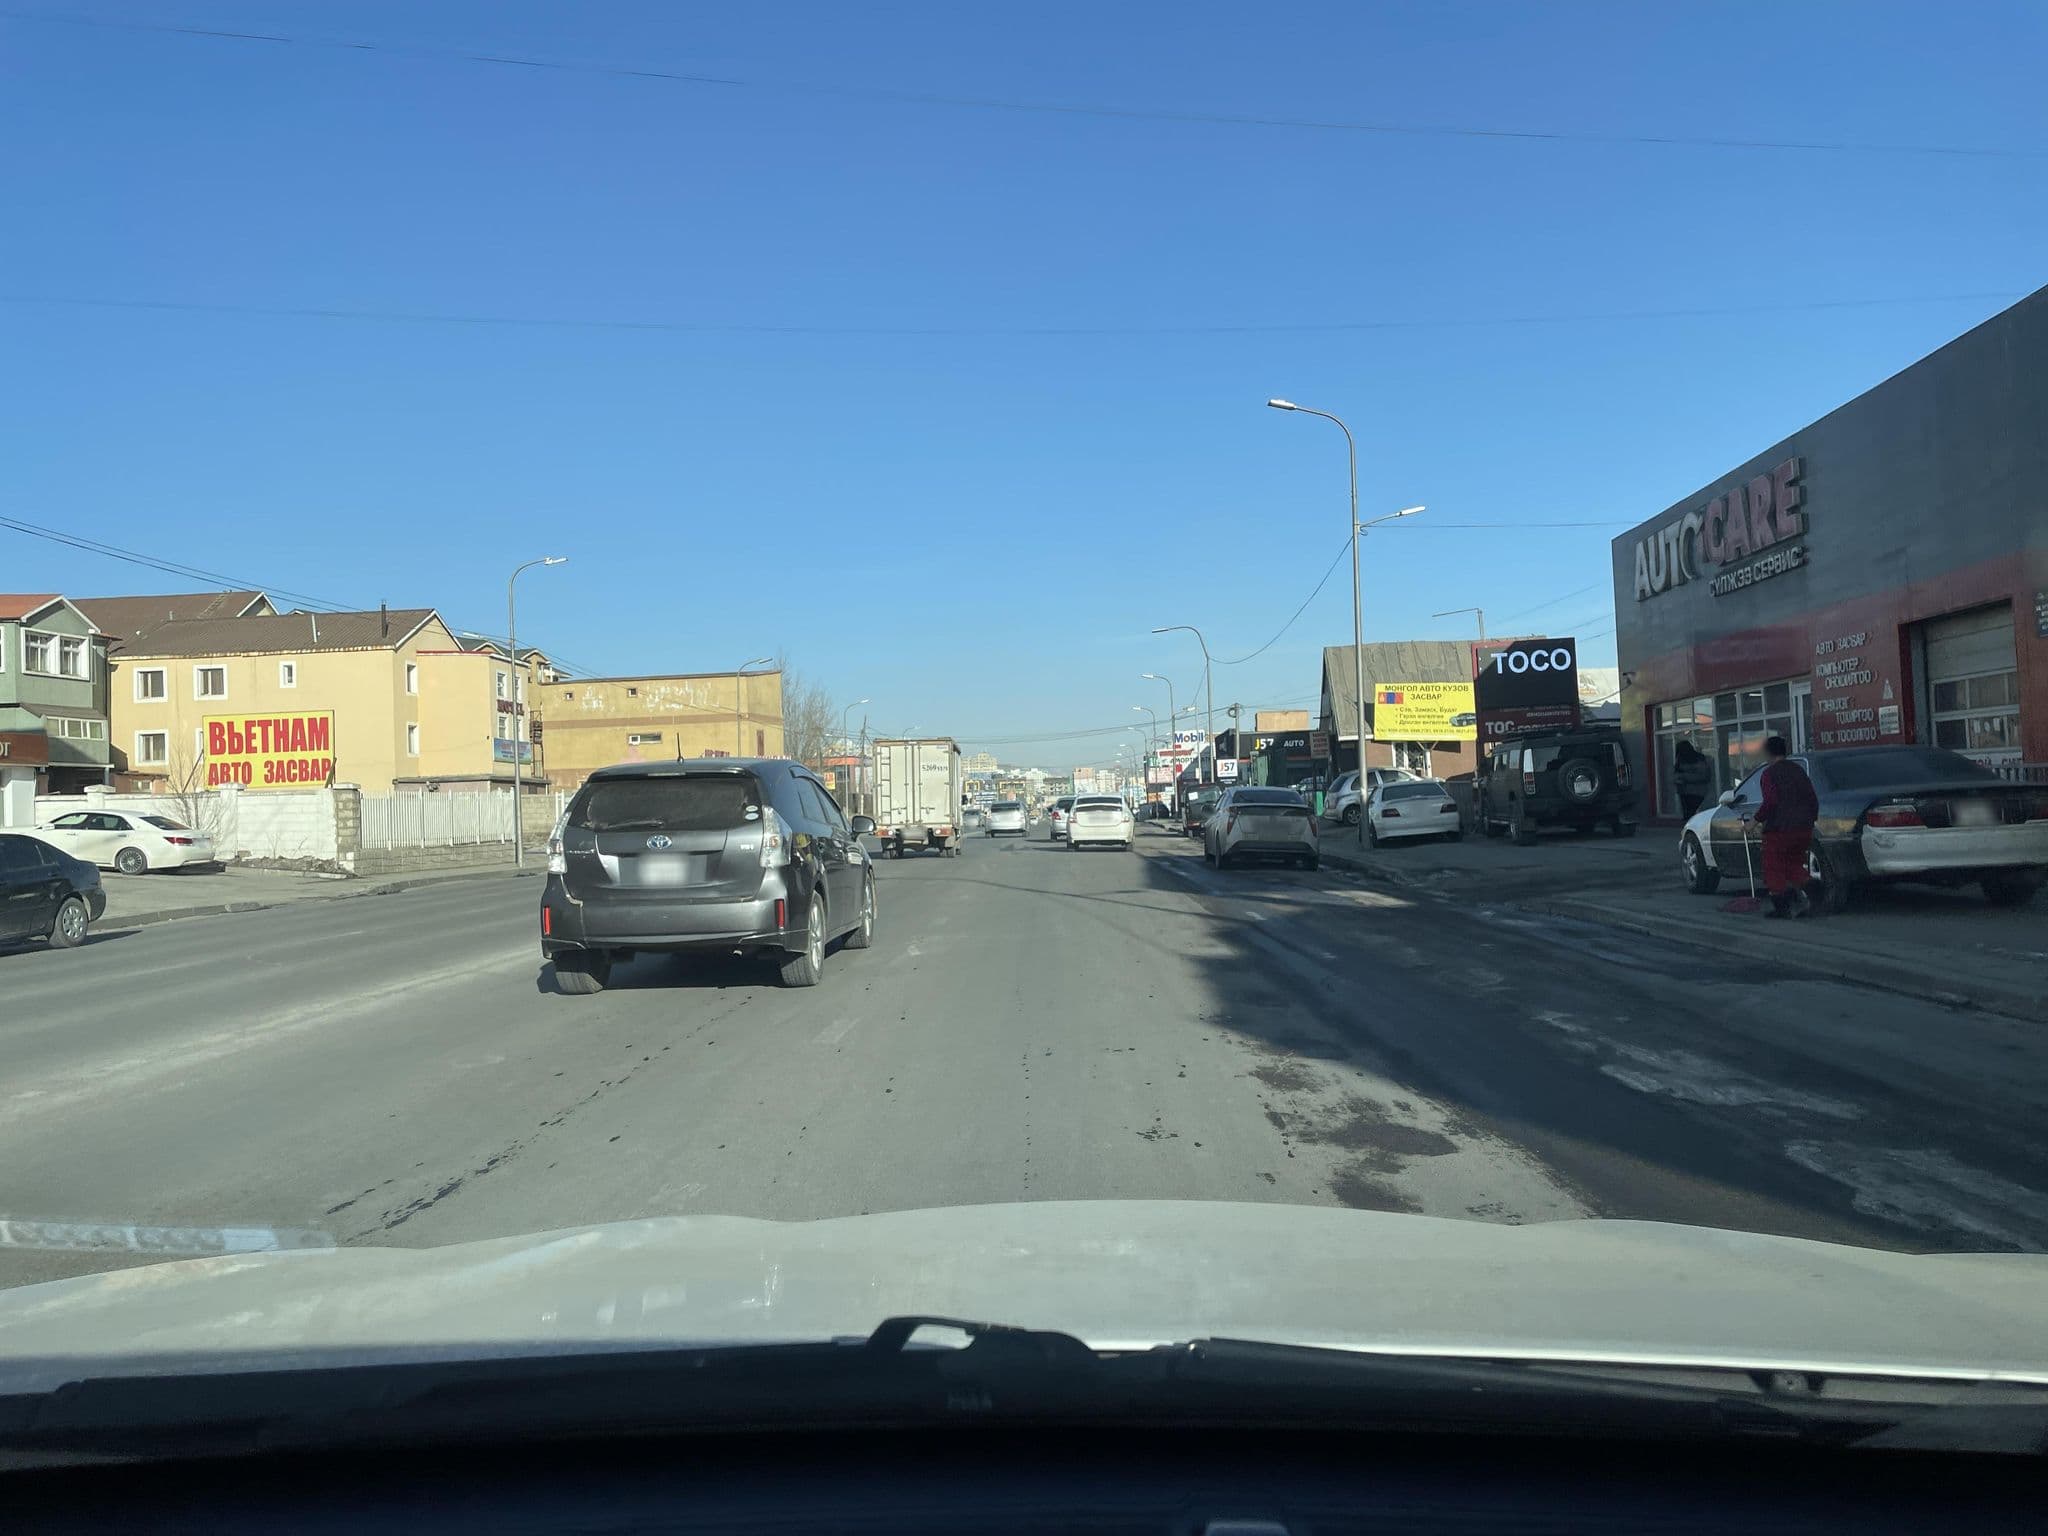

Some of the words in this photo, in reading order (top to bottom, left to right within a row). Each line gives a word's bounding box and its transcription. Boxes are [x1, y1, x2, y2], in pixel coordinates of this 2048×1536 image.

[1752, 546, 1801, 583] СЕРВИС
[1816, 640, 1834, 655] АВТО
[1839, 633, 1866, 650] ЗАСВАР
[1384, 684, 1418, 692] МОНГОЛ
[1410, 693, 1442, 701] ЗАСВАР
[209, 717, 330, 755] ВЬЕТНАМ
[1174, 732, 1204, 744] Mobil
[1283, 739, 1305, 748] AUTO
[208, 761, 253, 786] АВТО
[263, 758, 331, 784] ЗАСВАР
